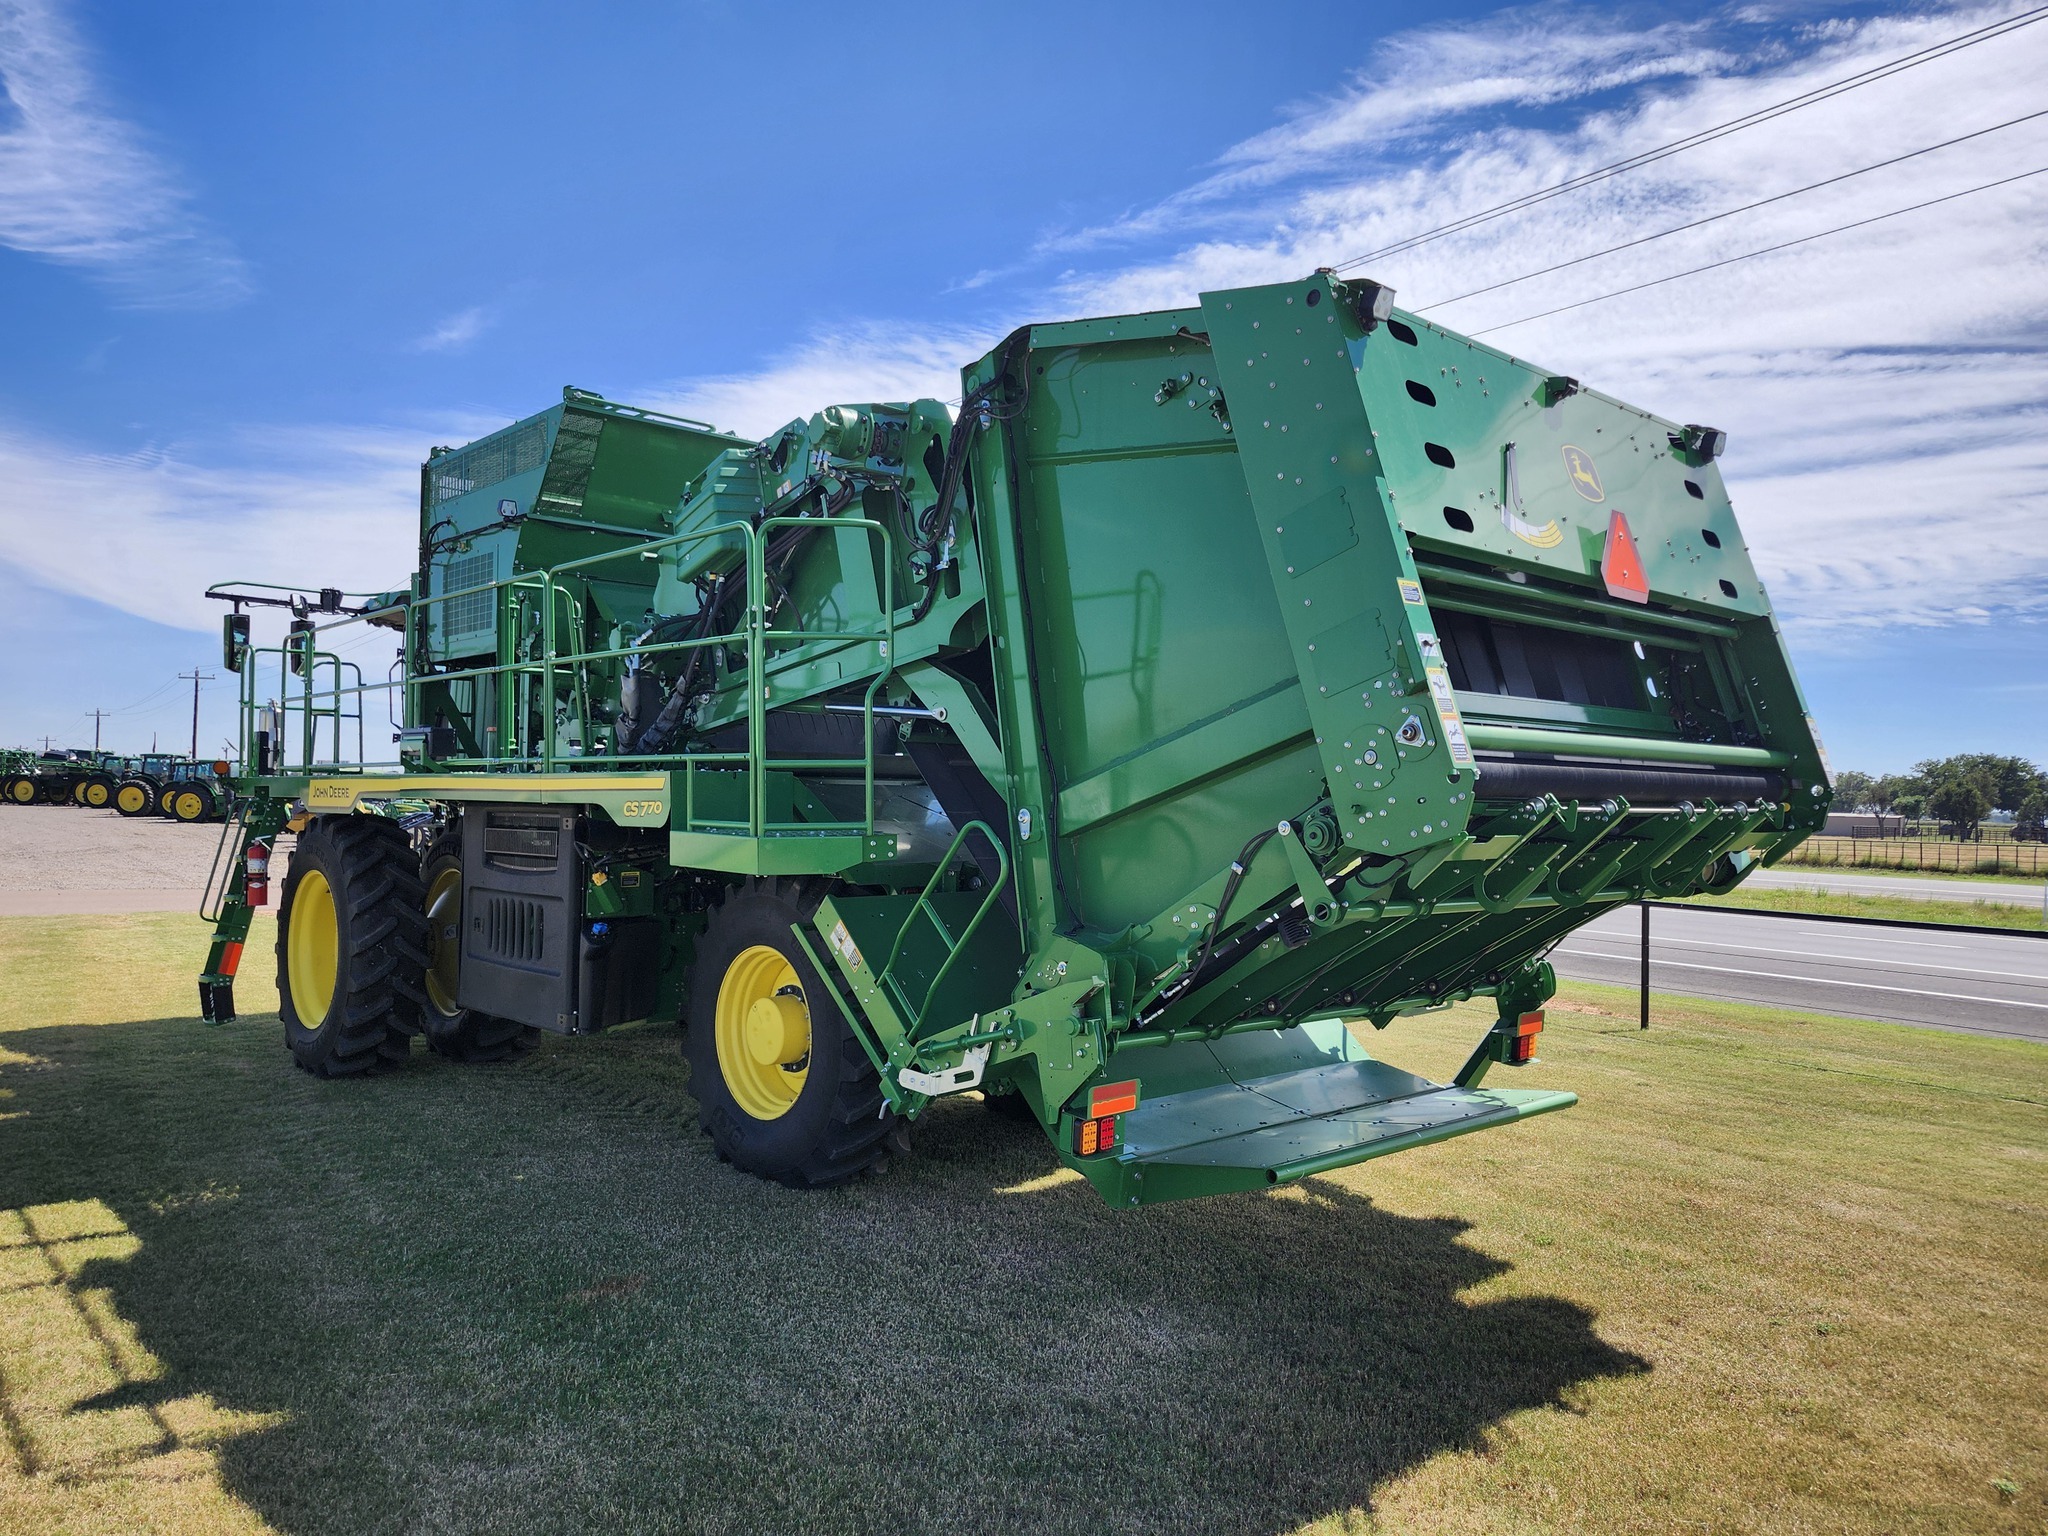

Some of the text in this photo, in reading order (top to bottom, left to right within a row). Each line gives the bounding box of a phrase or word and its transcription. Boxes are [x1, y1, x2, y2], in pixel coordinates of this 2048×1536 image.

[313, 785, 349, 798] JOHN DEERE
[623, 800, 663, 817] CS 770
